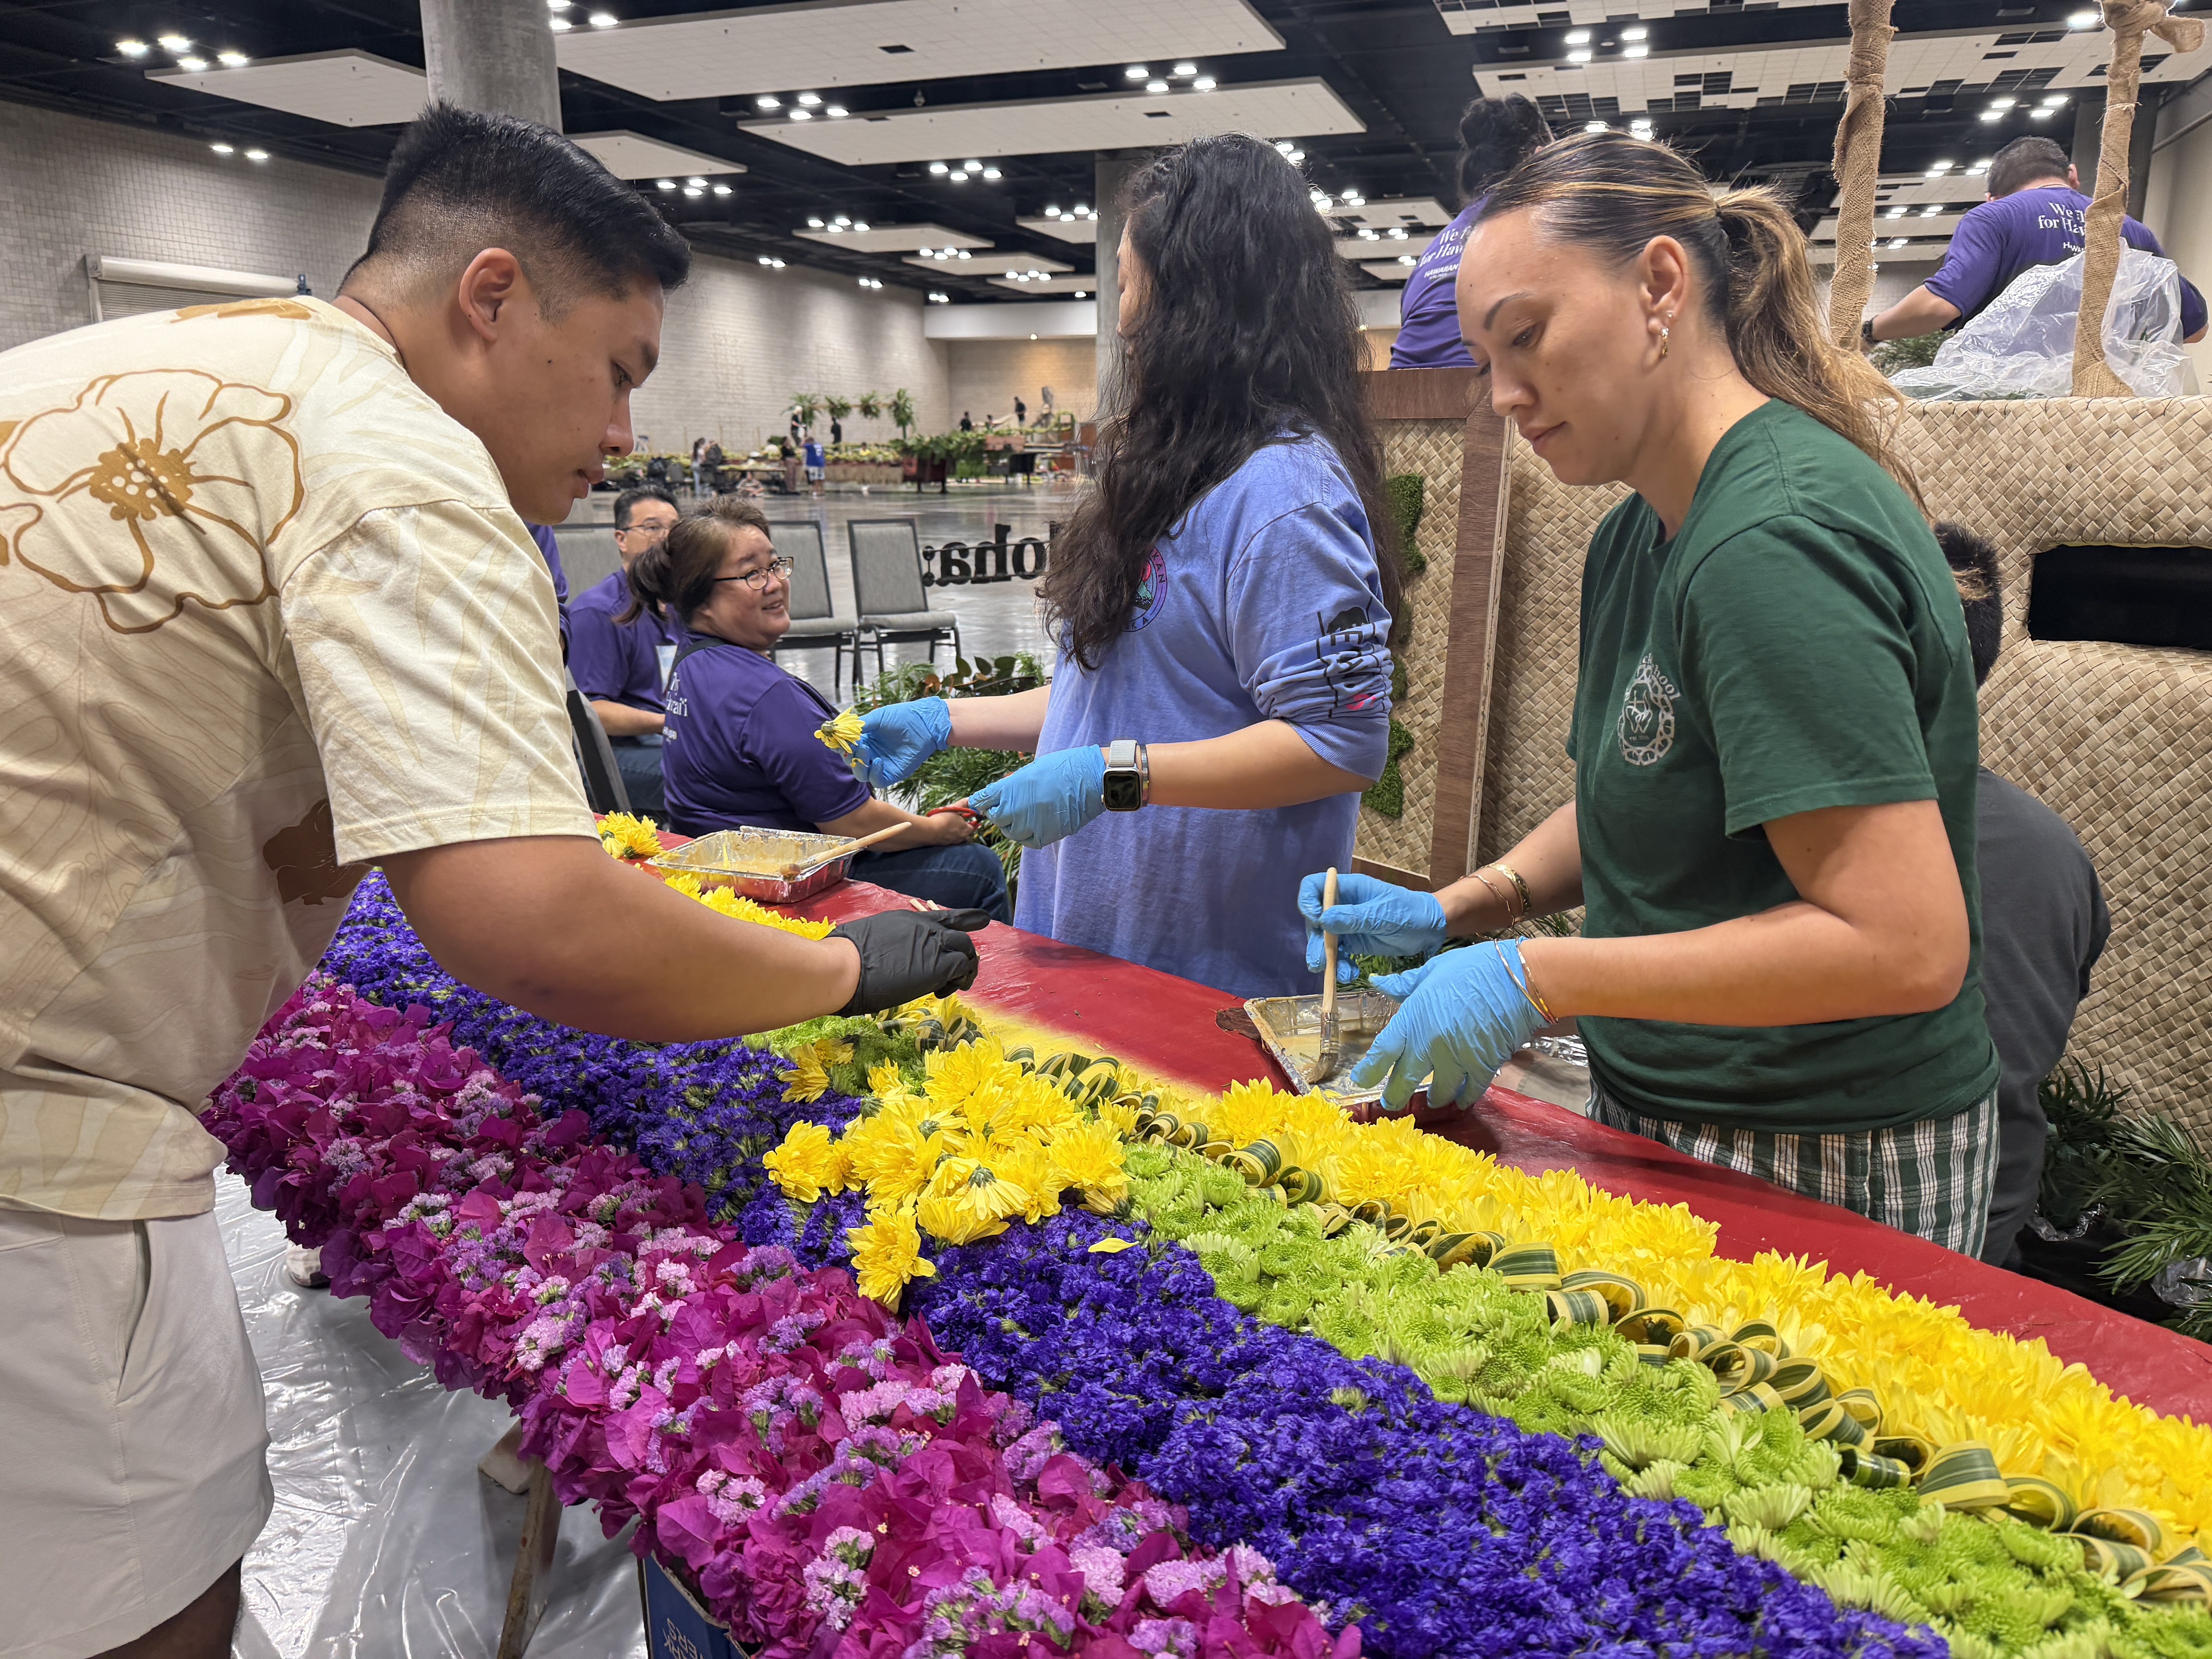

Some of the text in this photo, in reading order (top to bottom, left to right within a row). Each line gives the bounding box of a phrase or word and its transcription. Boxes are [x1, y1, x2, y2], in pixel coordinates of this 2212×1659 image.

[2048, 202, 2073, 218] We
[2038, 215, 2059, 229] for
[1439, 228, 1459, 245] We
[1419, 252, 1436, 267] for
